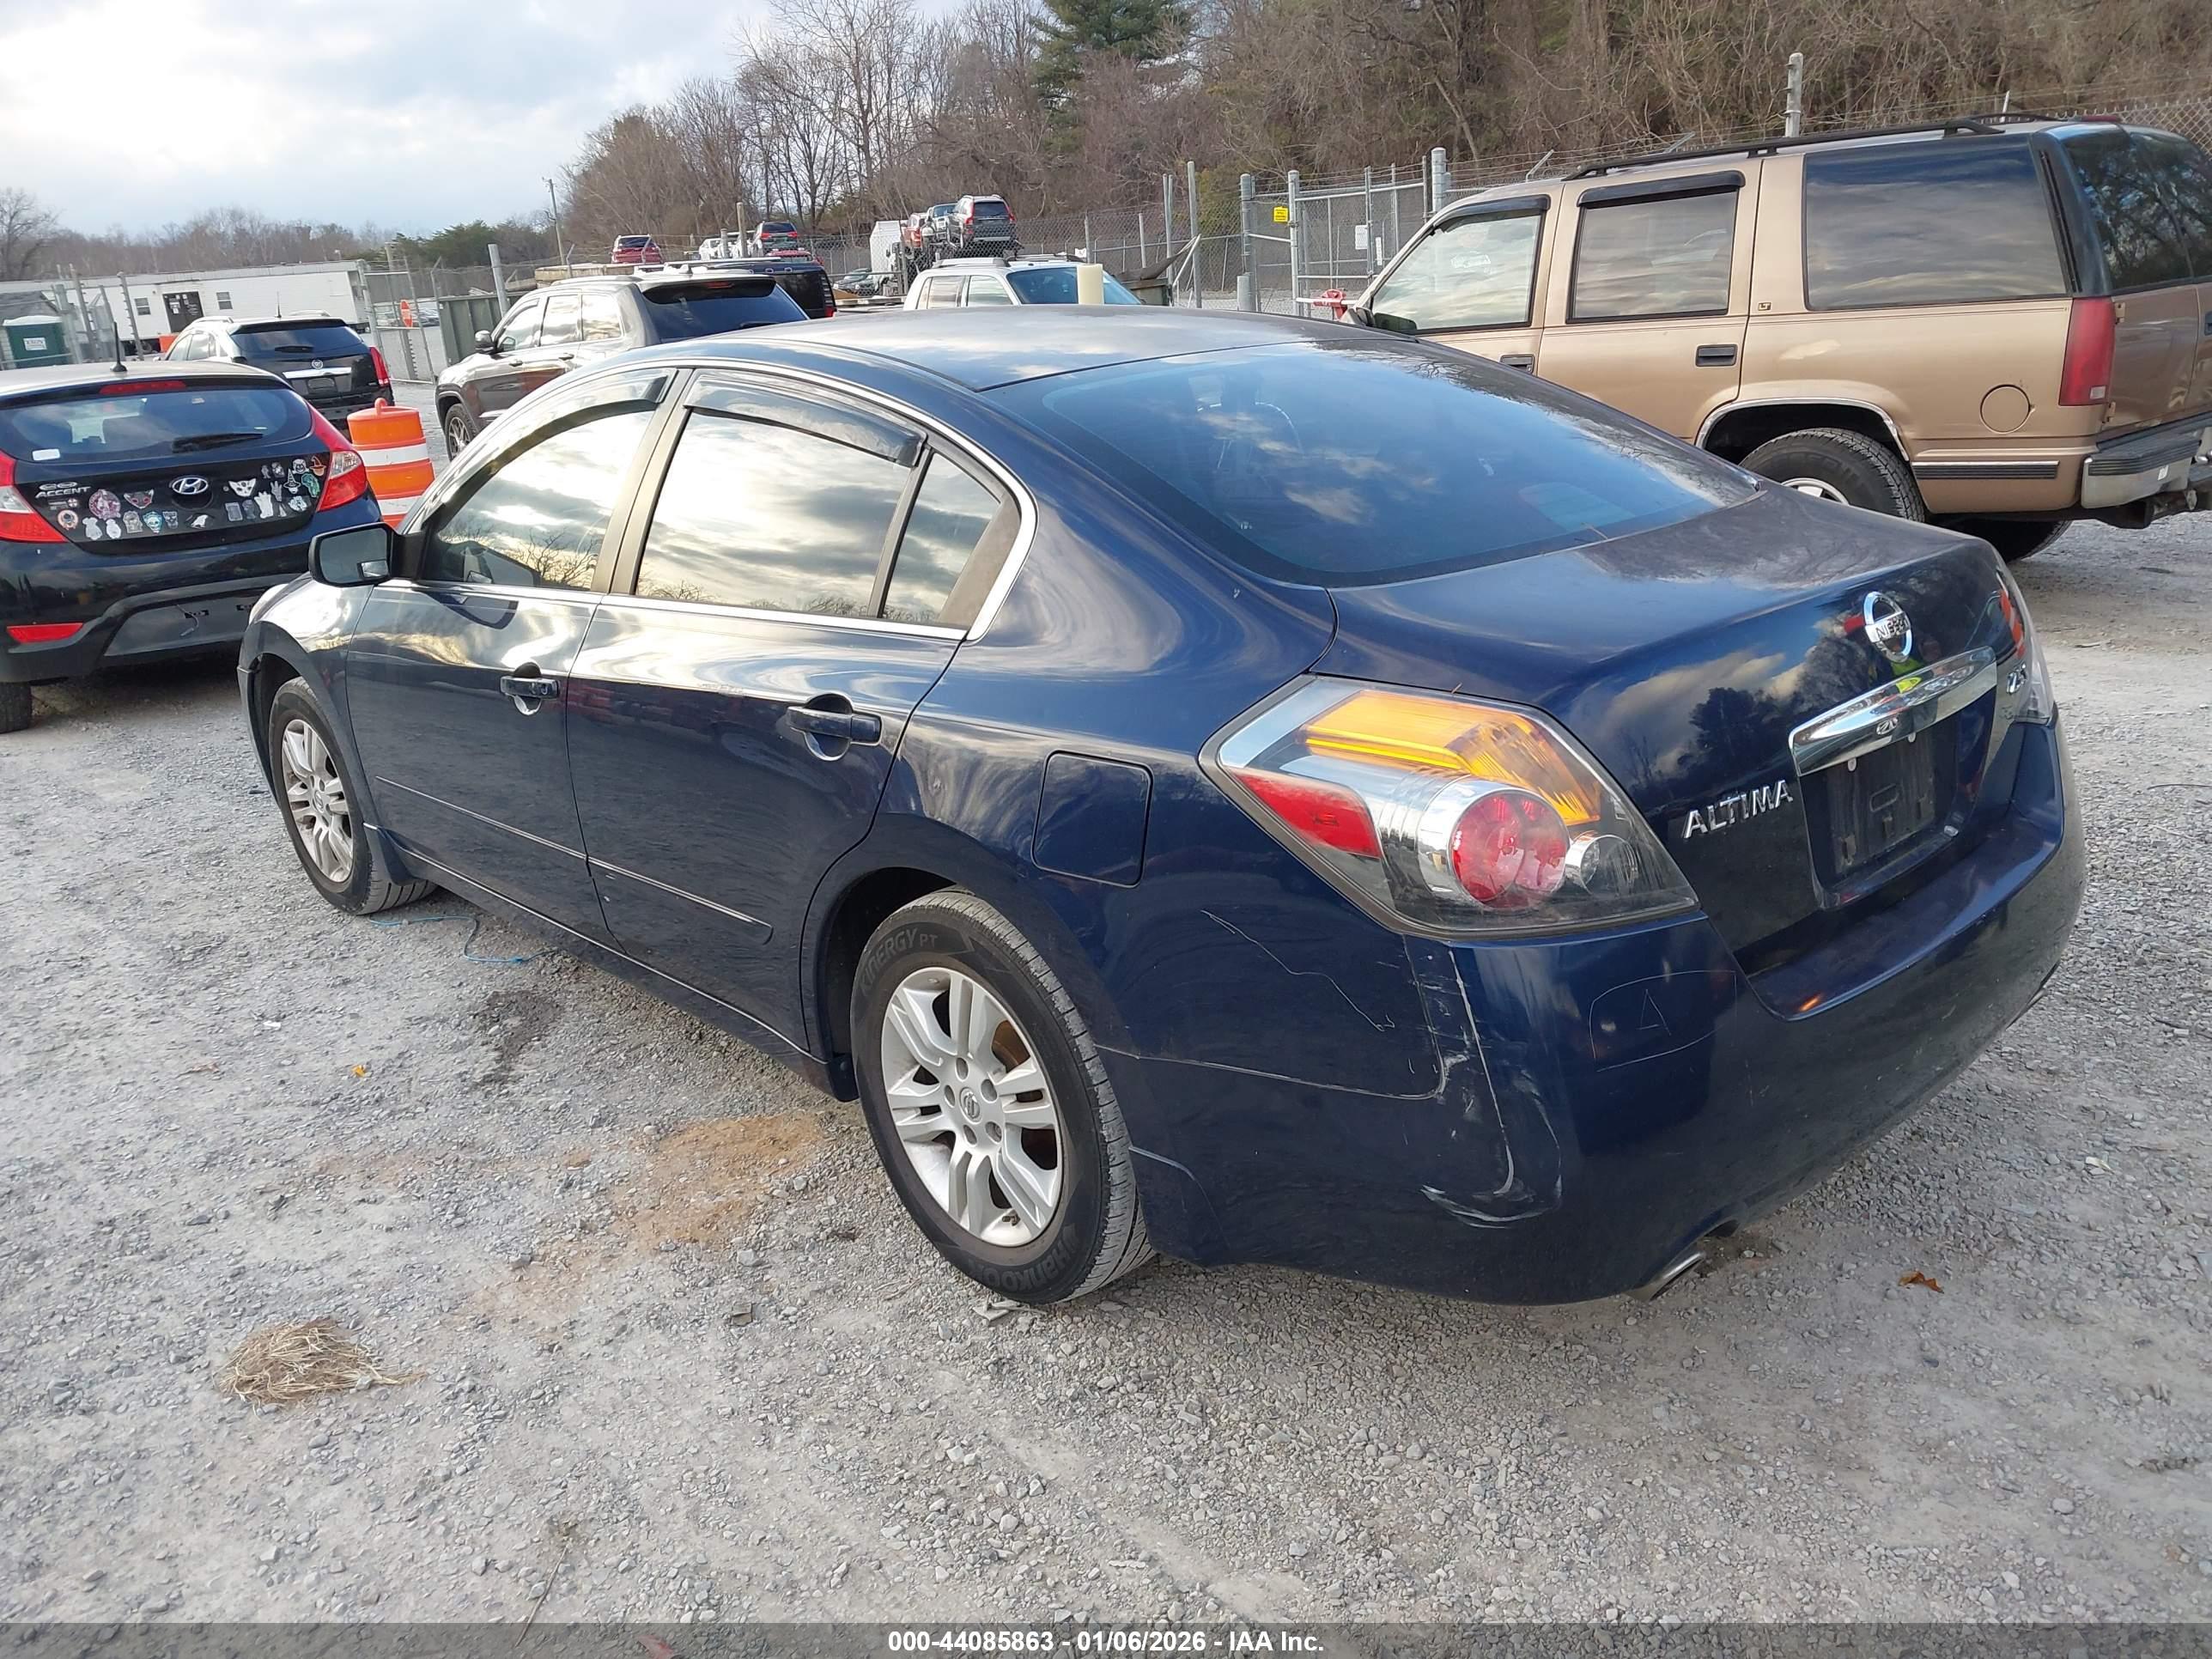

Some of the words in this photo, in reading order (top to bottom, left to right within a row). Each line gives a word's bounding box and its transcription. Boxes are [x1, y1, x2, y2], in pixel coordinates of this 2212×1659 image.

[34, 486, 92, 499] ACCENT
[1682, 779, 1794, 839] ALTIMA
[920, 933, 939, 948] PT
